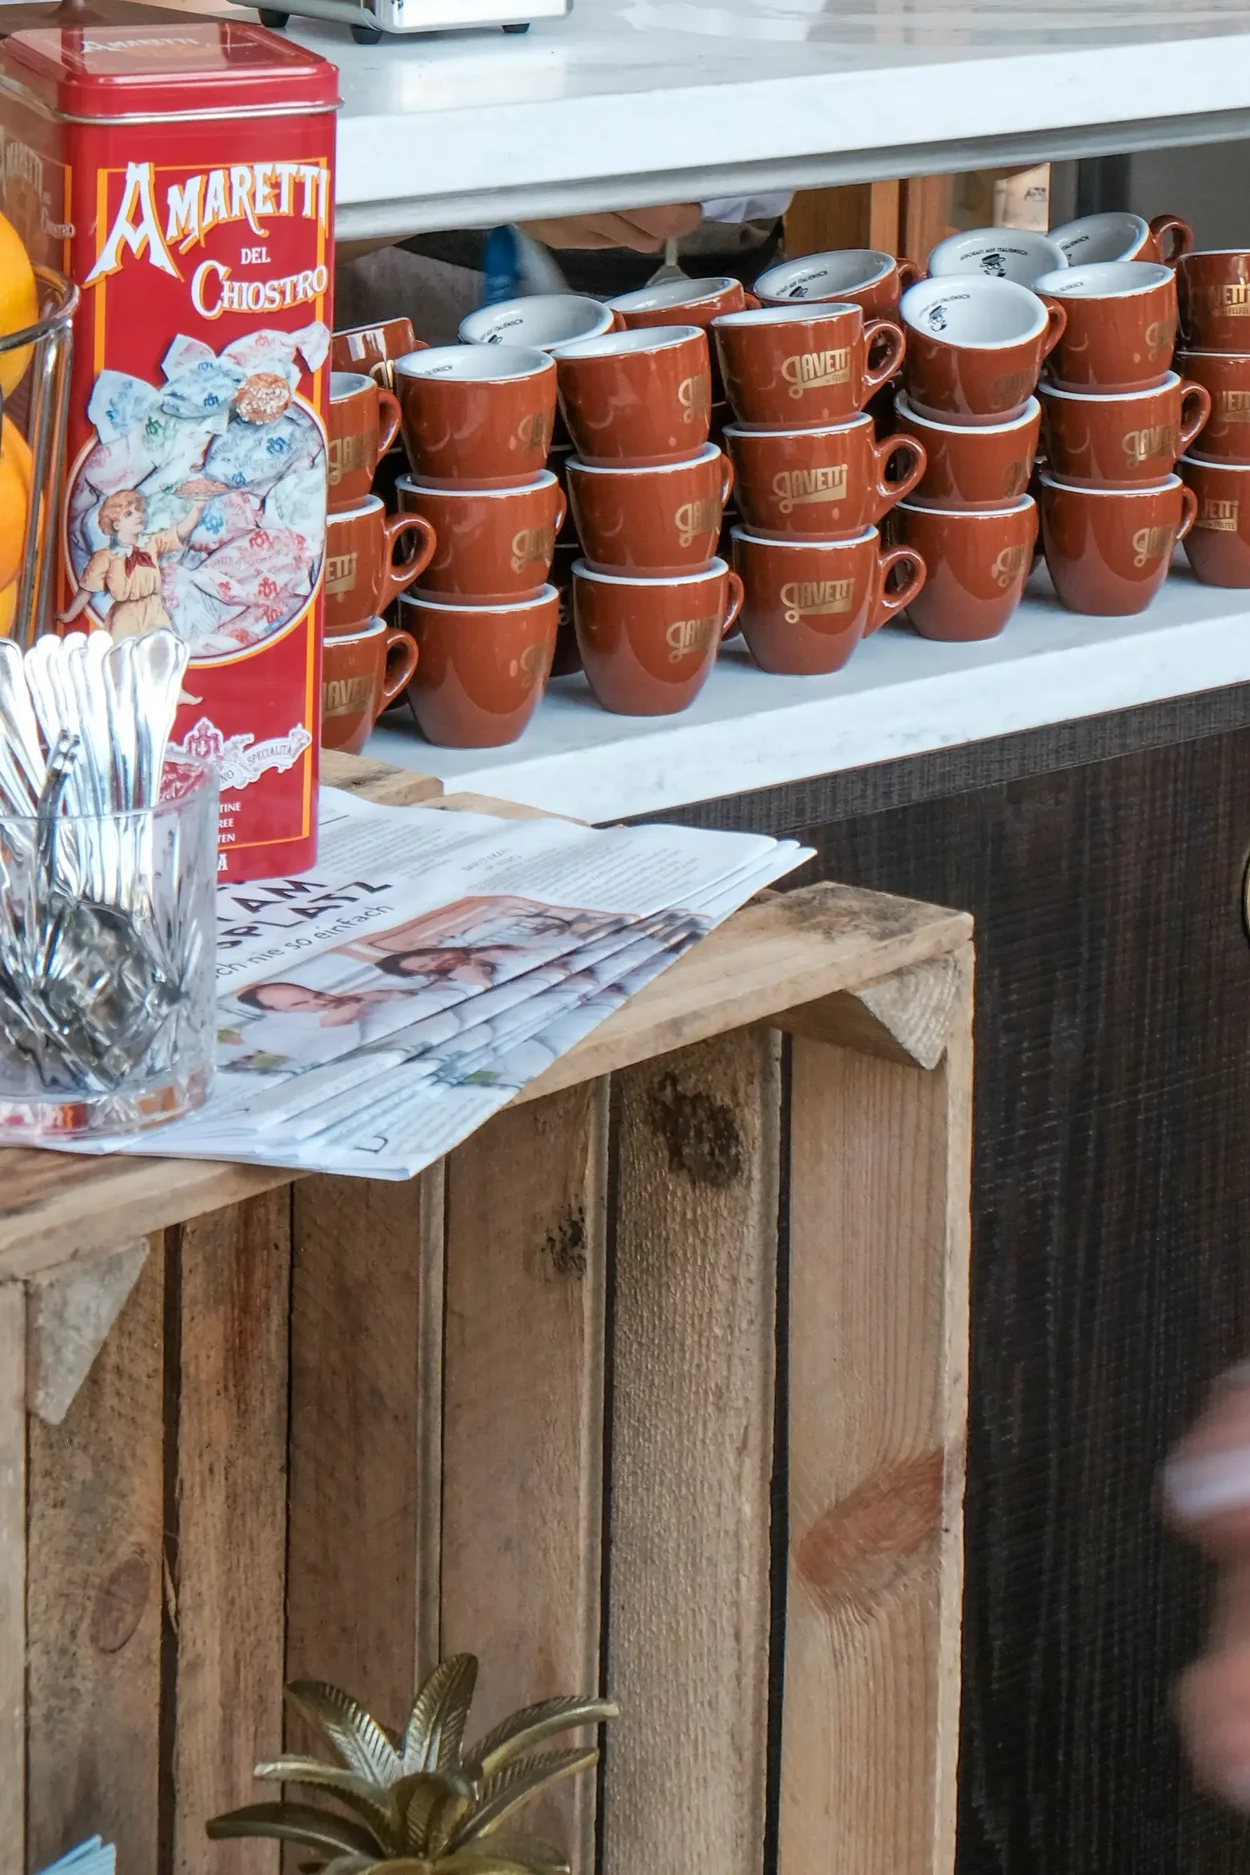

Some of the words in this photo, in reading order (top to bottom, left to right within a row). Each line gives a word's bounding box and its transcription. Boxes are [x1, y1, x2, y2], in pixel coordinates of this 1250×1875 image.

[82, 161, 331, 289] AMARETTI
[241, 247, 271, 265] DEL
[191, 259, 329, 320] CHIOSTRO
[252, 947, 285, 965] nie
[284, 938, 313, 951] so
[313, 904, 396, 941] einfach
